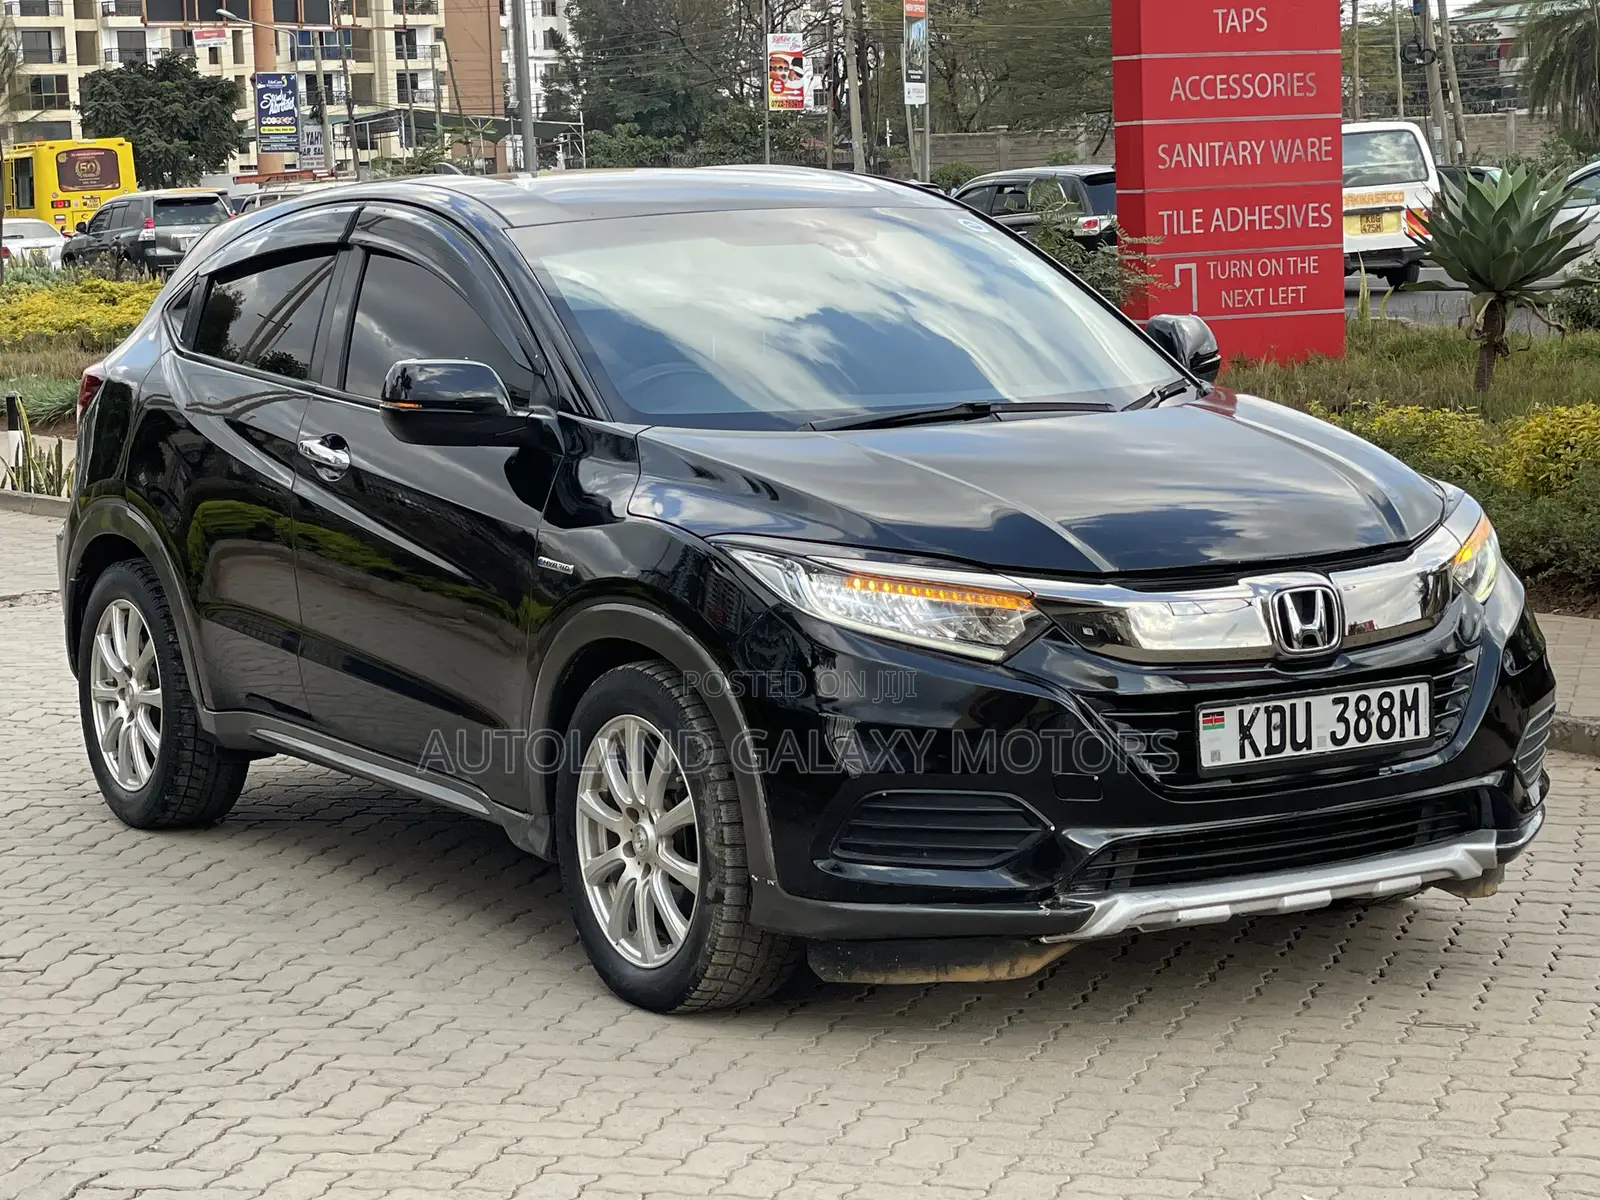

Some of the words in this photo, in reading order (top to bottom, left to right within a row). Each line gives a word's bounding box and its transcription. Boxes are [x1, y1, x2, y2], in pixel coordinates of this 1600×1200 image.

[1212, 7, 1268, 34] TAPS
[260, 89, 286, 110] Study
[1169, 71, 1318, 102] ACCESSORIES
[268, 96, 295, 116] Abroad
[1157, 139, 1266, 170] SANITARY
[1270, 136, 1333, 165] WARE
[79, 162, 96, 173] 50
[1158, 208, 1204, 236] TILE
[1210, 203, 1333, 233] ADHESIVES
[1207, 259, 1253, 280] TURN
[1257, 258, 1283, 277] ON
[1286, 255, 1319, 275] THE
[1221, 288, 1264, 308] NEXT
[1269, 285, 1307, 305] LEFT
[1237, 700, 1313, 760] KDU
[1329, 686, 1421, 748] 388M
